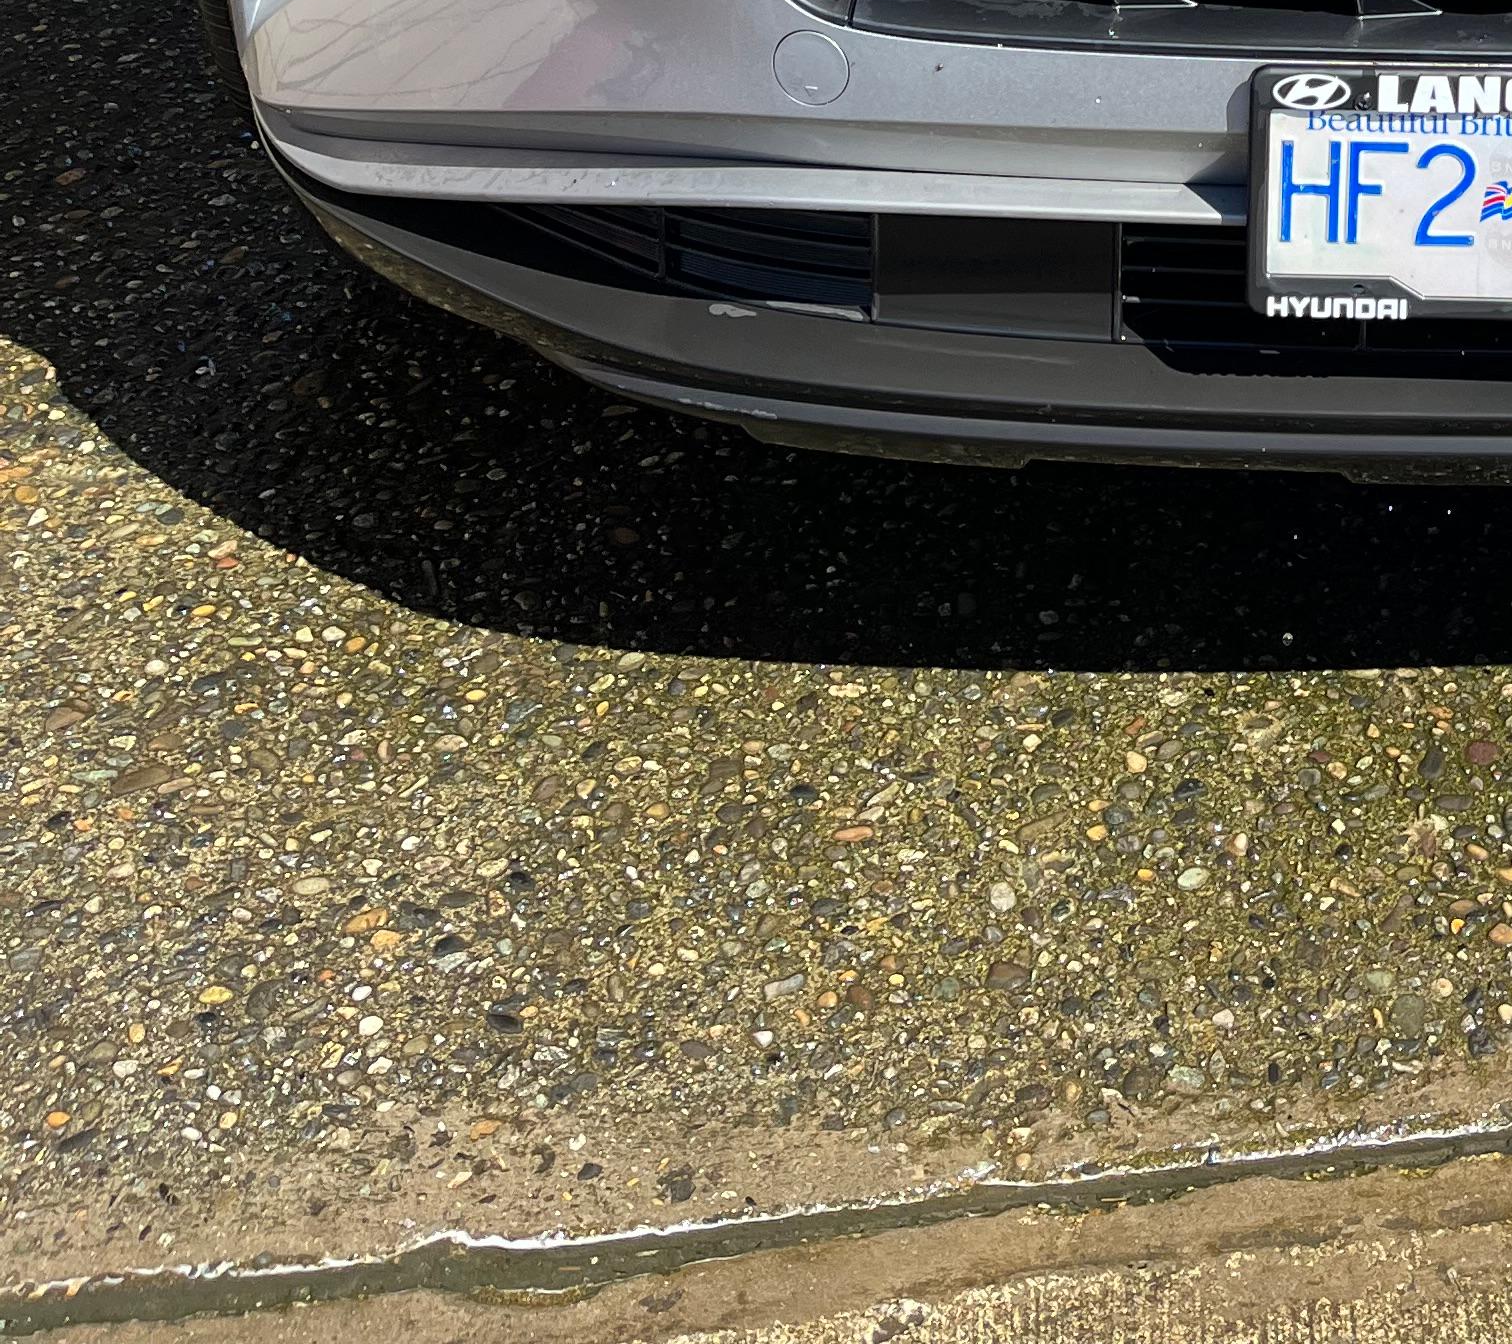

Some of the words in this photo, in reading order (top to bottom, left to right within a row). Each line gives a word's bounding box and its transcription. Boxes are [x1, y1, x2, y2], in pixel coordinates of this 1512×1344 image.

[1306, 111, 1449, 134] Beautiful
[1278, 139, 1477, 248] HF2
[1266, 296, 1408, 320] HYUNDAI
